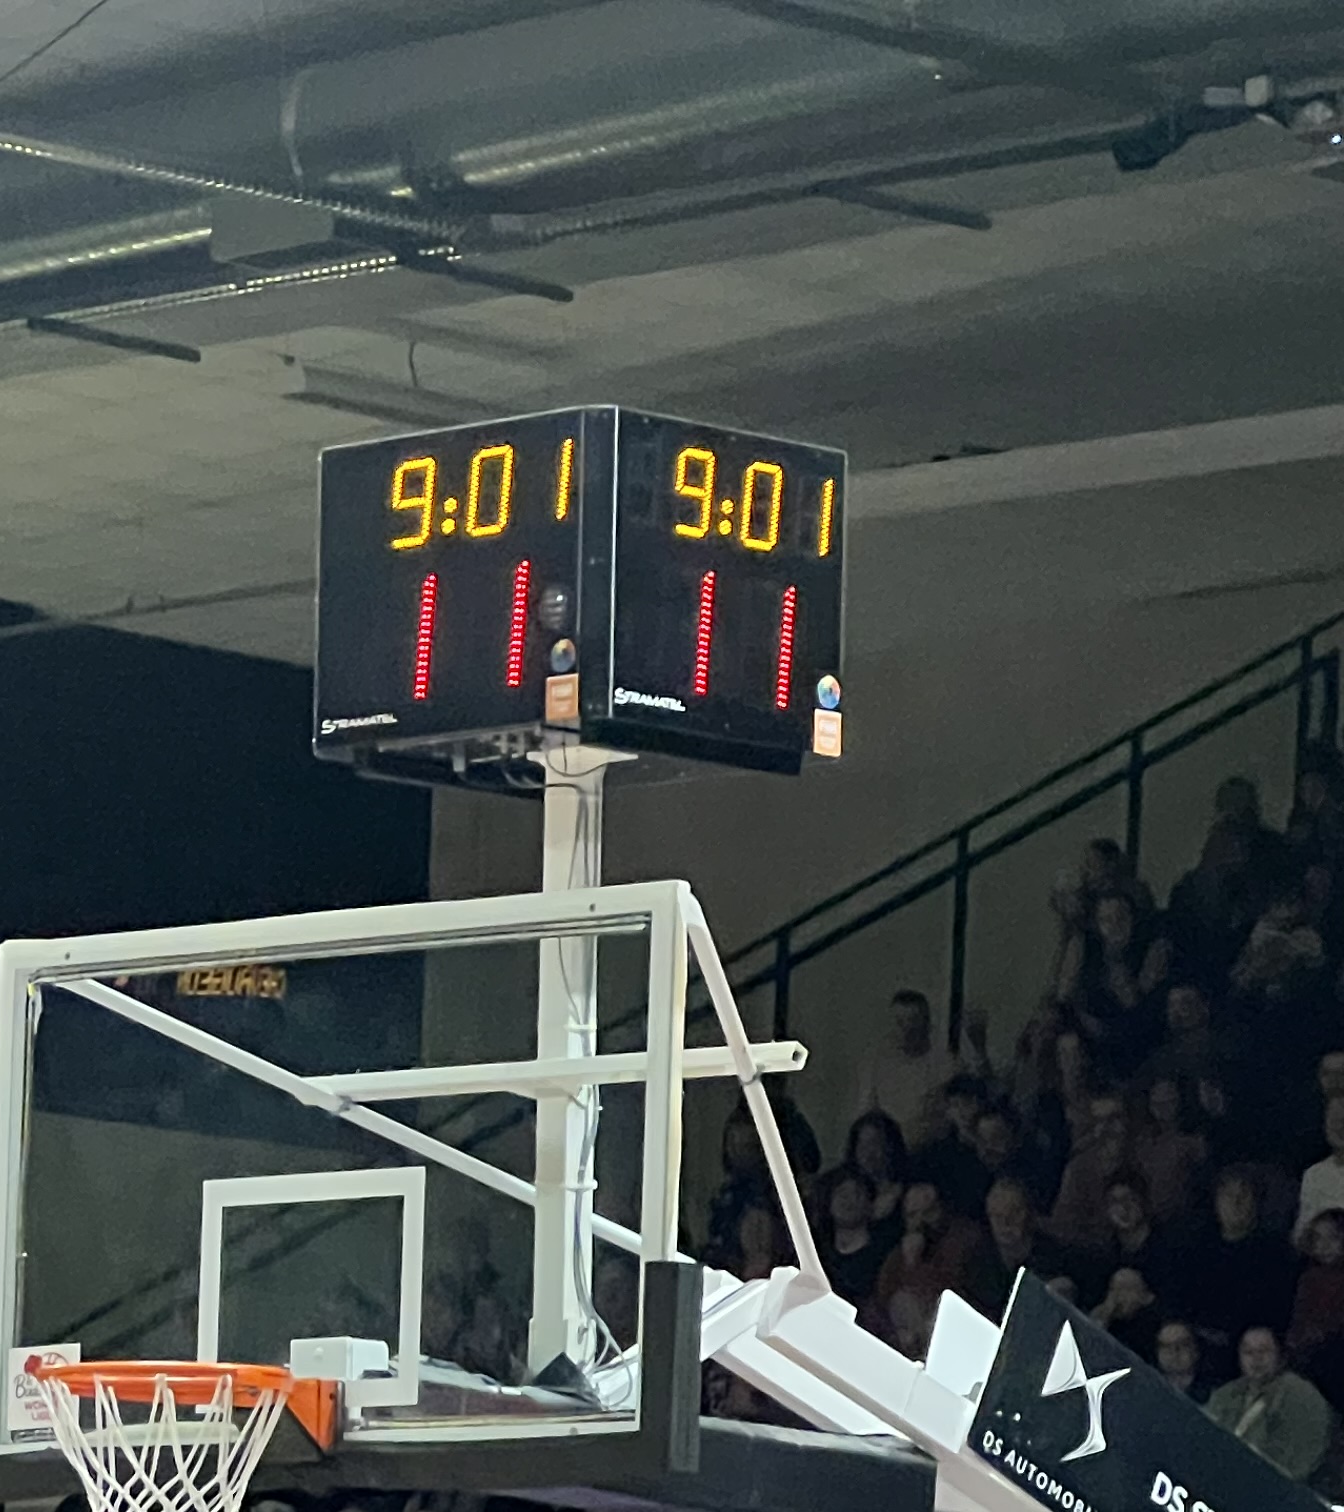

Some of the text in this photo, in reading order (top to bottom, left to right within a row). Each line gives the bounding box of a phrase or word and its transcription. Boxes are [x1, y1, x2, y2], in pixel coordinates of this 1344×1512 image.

[390, 437, 574, 550] 9:01
[674, 446, 835, 557] 9:01
[981, 1429, 1005, 1458] DS
